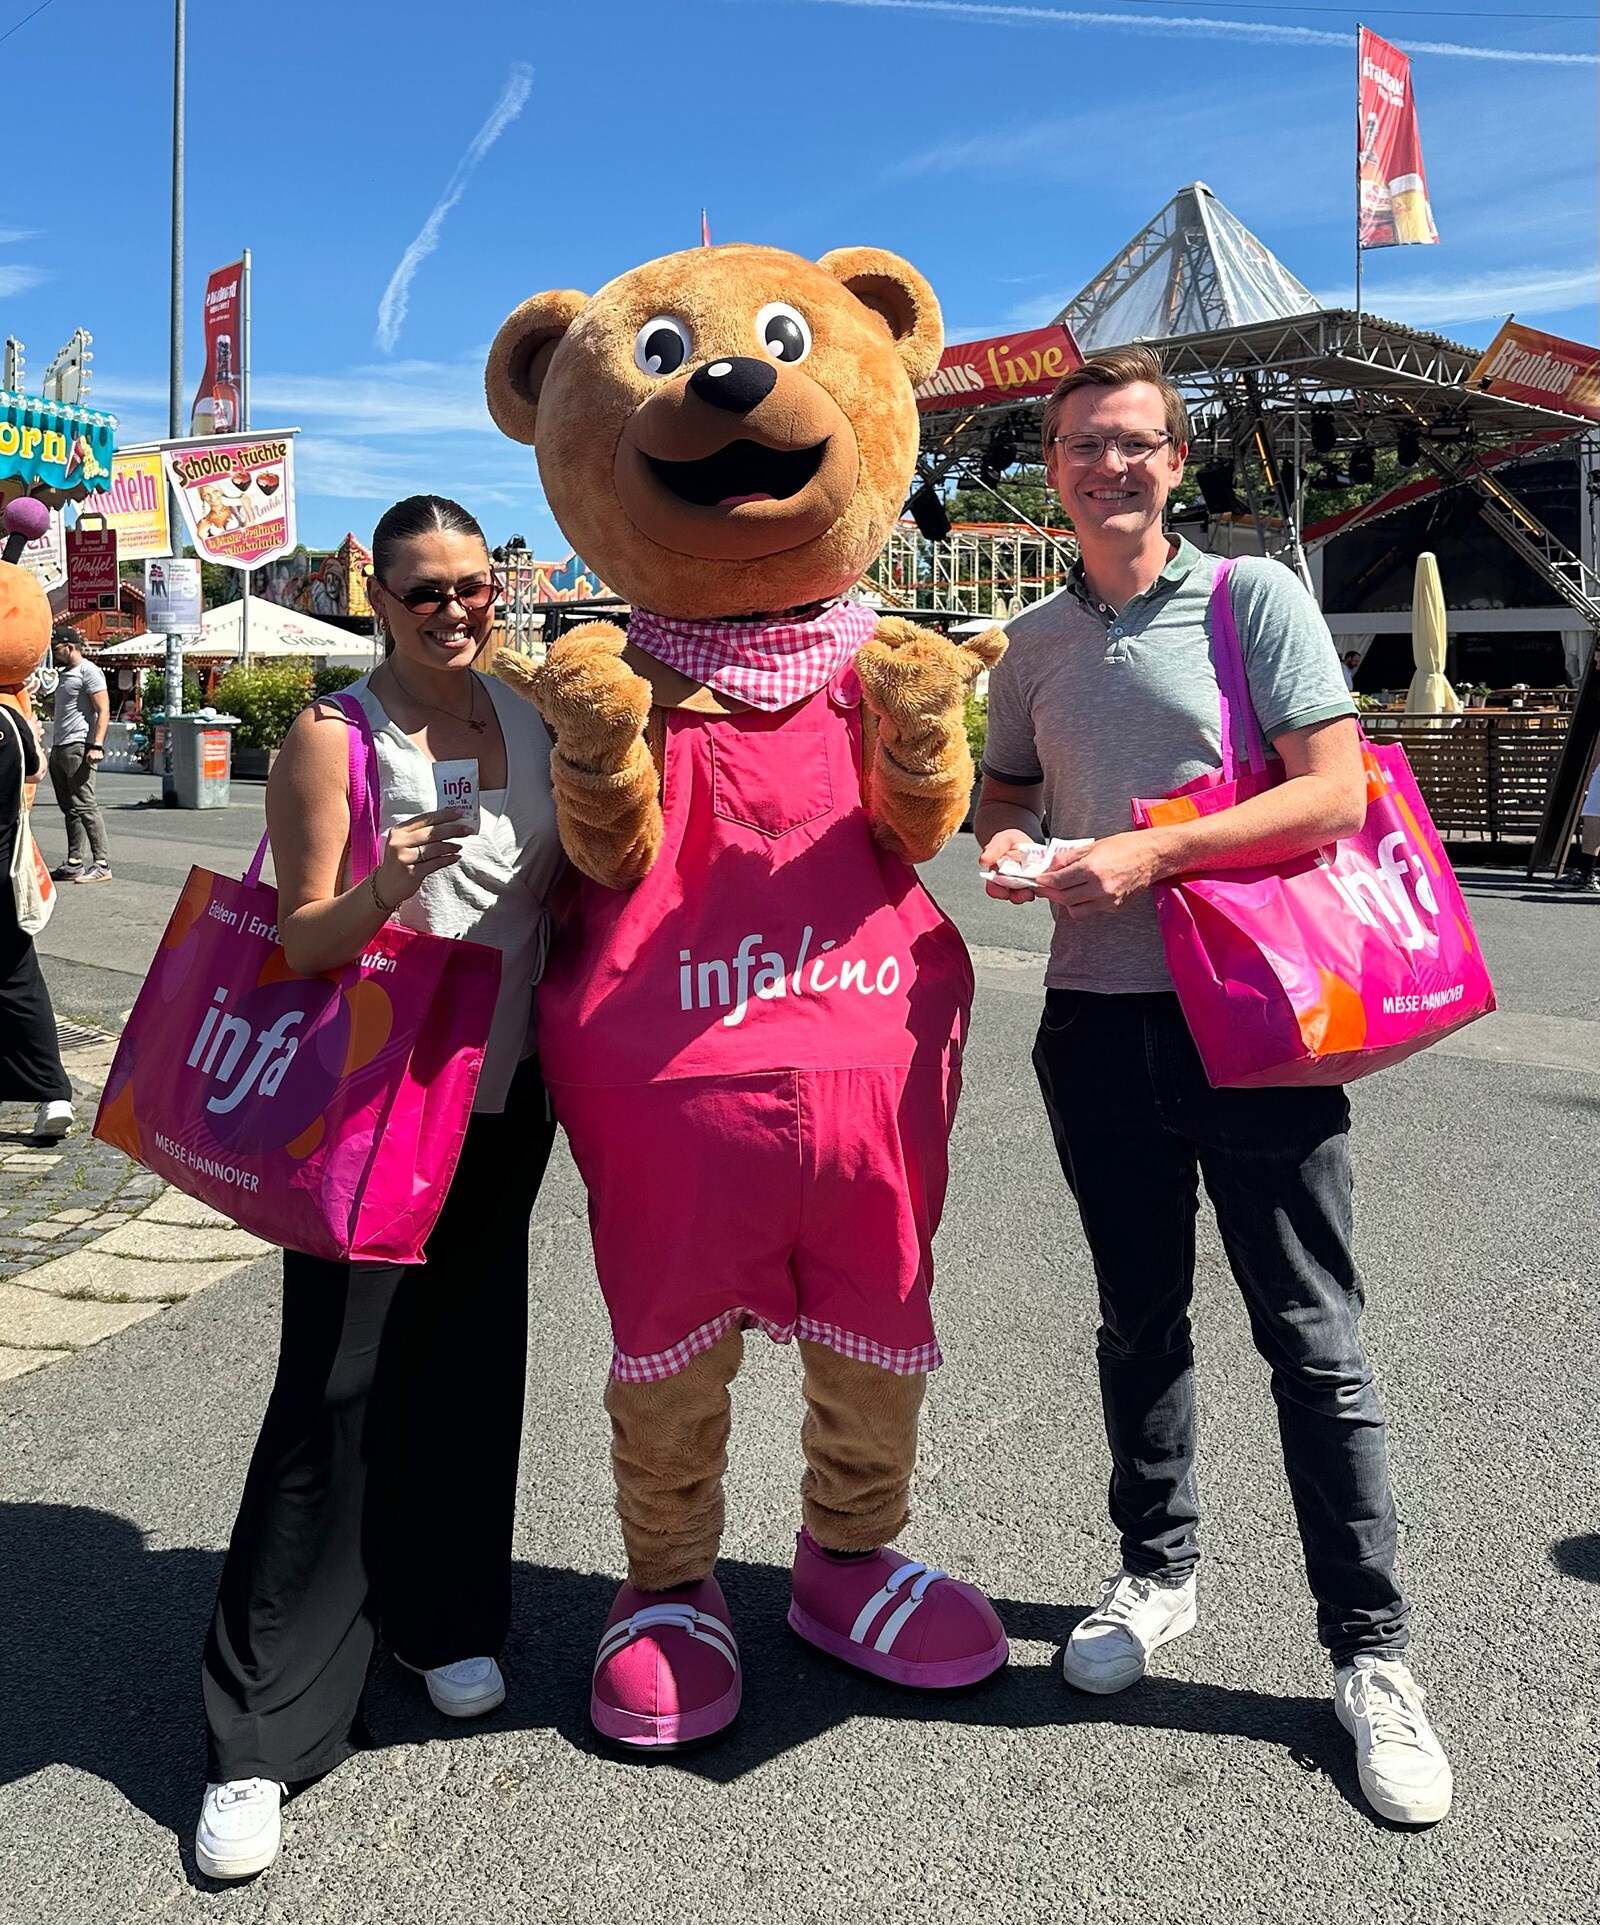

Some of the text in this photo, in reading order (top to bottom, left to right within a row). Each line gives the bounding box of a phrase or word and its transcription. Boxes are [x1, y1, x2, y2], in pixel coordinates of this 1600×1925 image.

[987, 345, 1069, 391] live
[1484, 338, 1579, 394] Brauhaus
[172, 442, 287, 488] Schoko- früchte
[71, 556, 114, 577] Waffel-
[70, 596, 87, 609] TÜTE
[443, 776, 472, 799] infa
[679, 925, 900, 1027] infalino
[1383, 984, 1464, 1014] MESSE HANNOVER
[186, 985, 305, 1114] infa
[155, 1131, 260, 1193] MESSE HANNOVER
